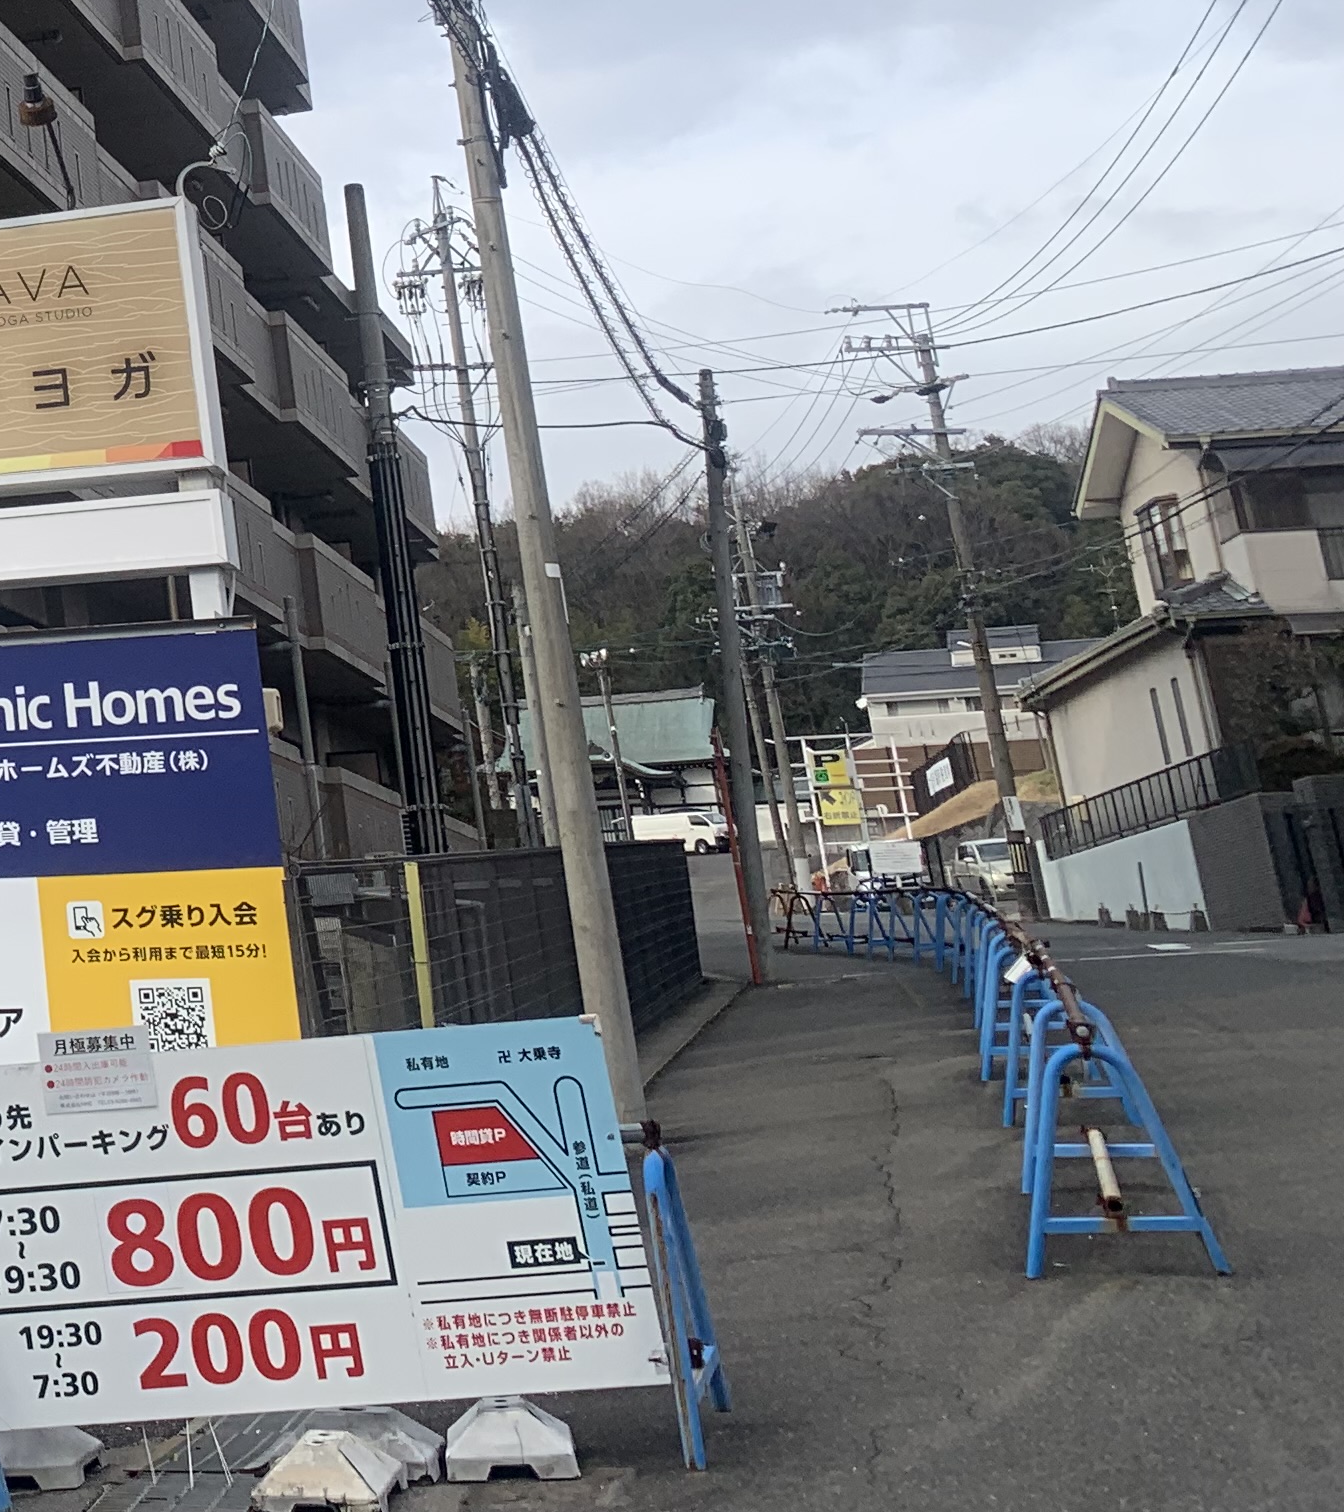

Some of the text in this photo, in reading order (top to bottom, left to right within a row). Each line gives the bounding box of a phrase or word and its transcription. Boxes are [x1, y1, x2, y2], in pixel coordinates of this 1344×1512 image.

[35, 306, 94, 324] STUDIO
[63, 680, 243, 729] Homes
[111, 900, 259, 929] スグ乗り入会
[53, 1033, 136, 1055] 月極募集中
[405, 1055, 450, 1072] 私有地
[465, 1170, 507, 1187] 契約P
[106, 1186, 378, 1288] 800円
[513, 1243, 575, 1265] 現在地
[17, 1319, 104, 1351] 19:30
[131, 1308, 366, 1391] 200円
[32, 1371, 100, 1400] 7:30
